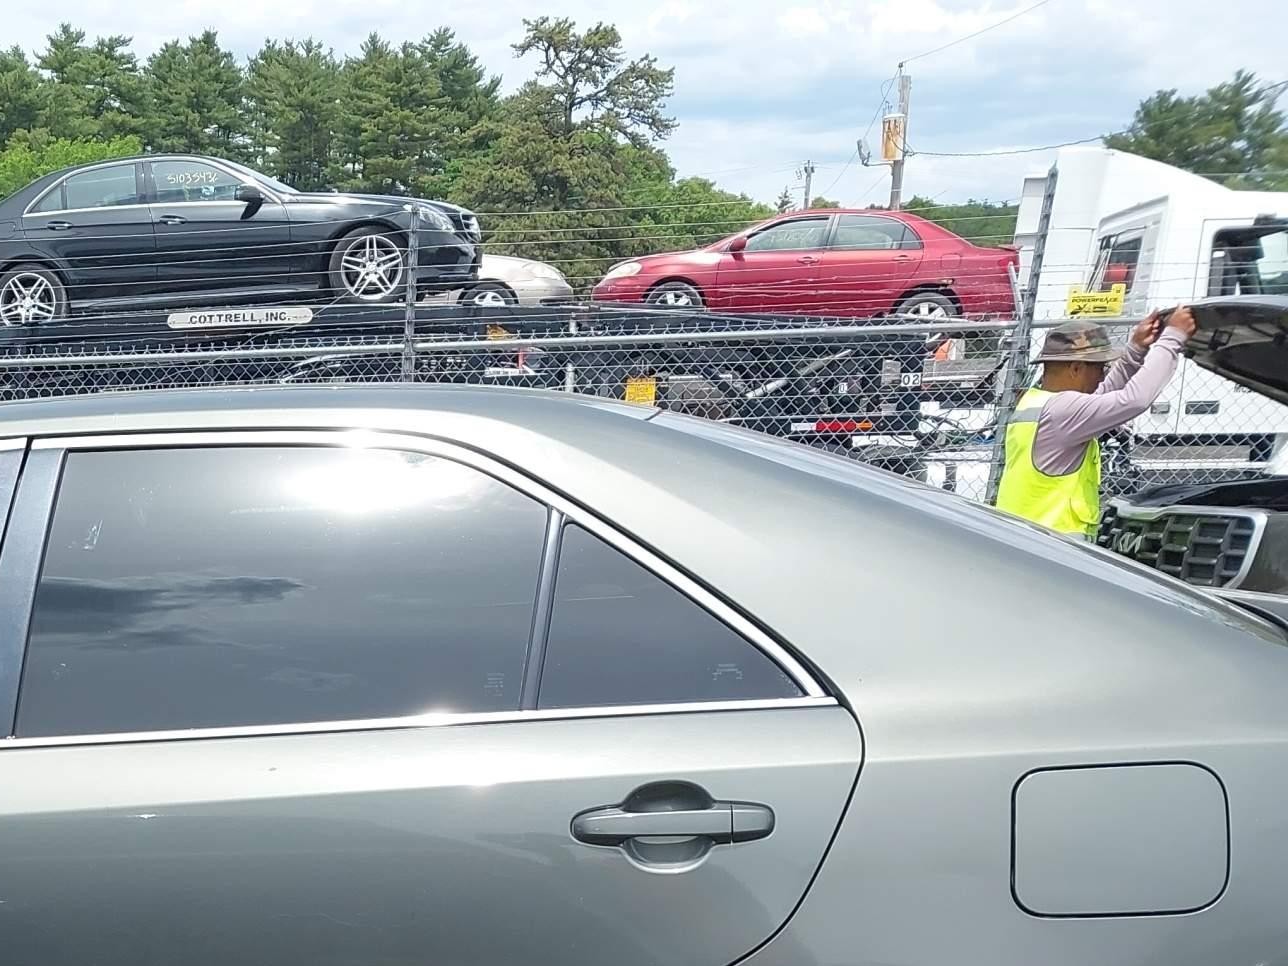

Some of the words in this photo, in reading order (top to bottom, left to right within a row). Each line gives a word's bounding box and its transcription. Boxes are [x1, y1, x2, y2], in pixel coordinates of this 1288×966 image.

[190, 313, 262, 324] COTTRELL,
[265, 311, 291, 322] INC.
[902, 374, 920, 385] 02
